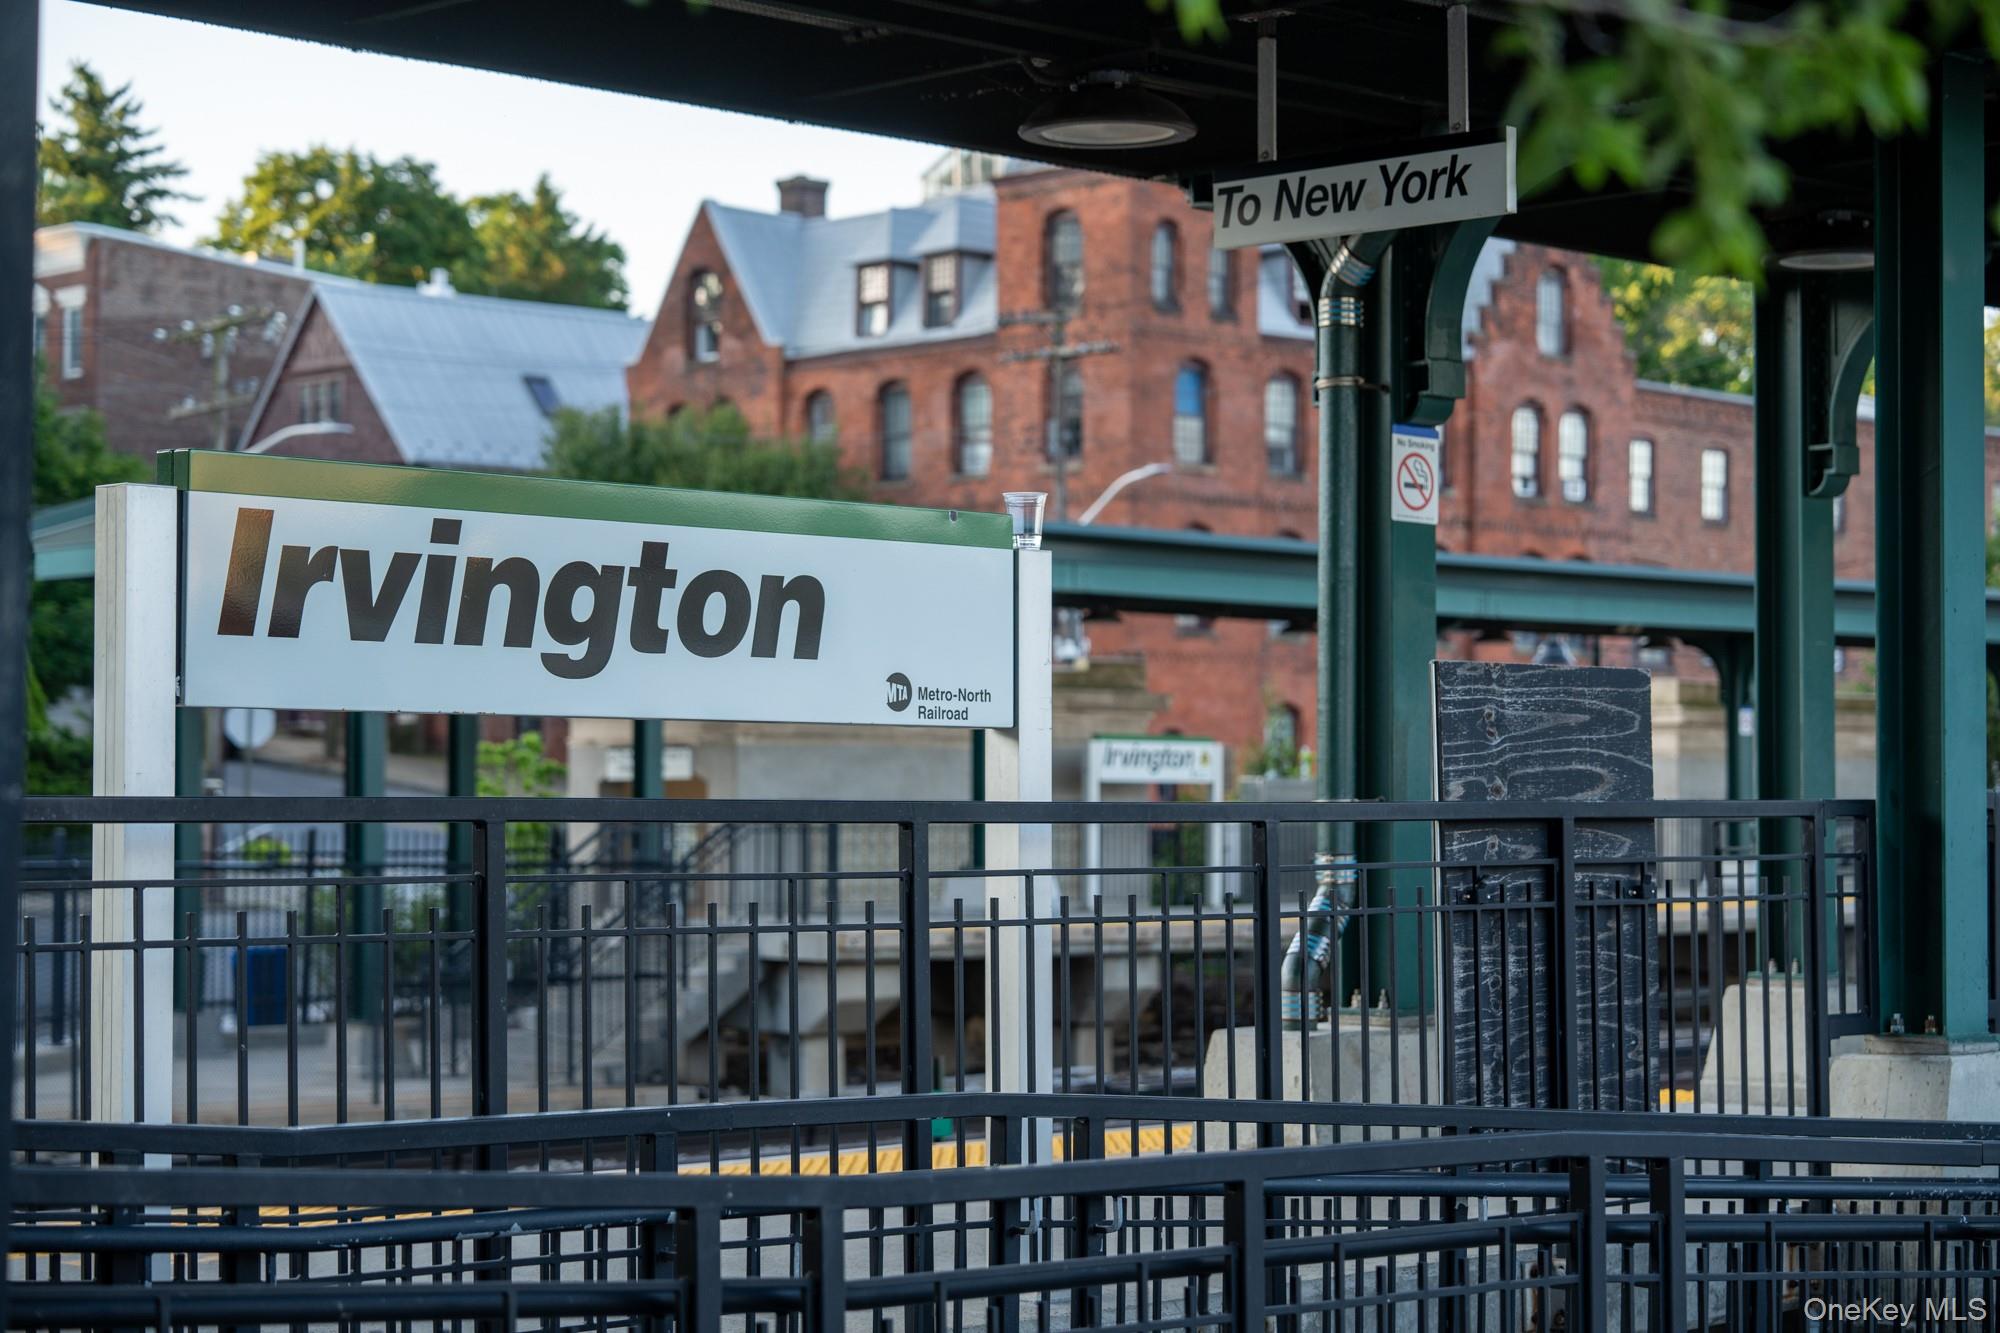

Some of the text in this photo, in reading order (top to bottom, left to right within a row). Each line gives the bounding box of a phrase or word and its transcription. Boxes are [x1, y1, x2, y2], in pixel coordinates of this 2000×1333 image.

[1217, 154, 1472, 228] To New York
[217, 507, 825, 680] Irvington
[885, 680, 909, 704] MTA
[918, 686, 991, 702] Metro-North
[918, 705, 968, 720] Railroad
[1104, 743, 1195, 773] Irvington
